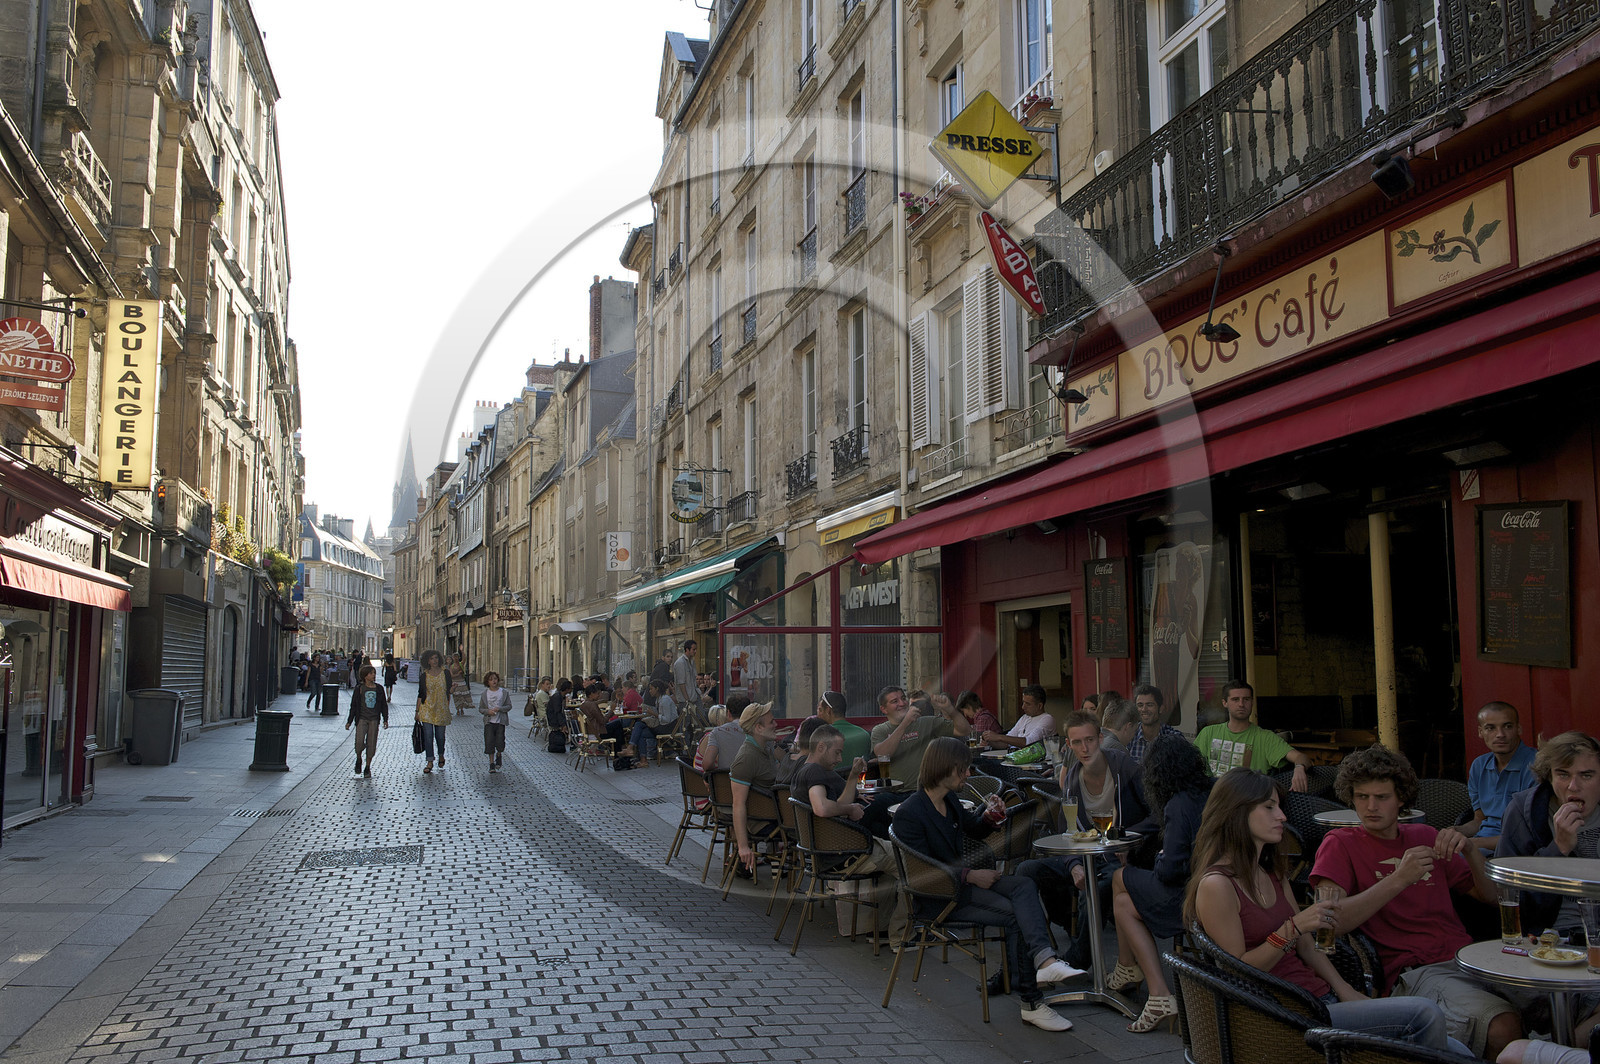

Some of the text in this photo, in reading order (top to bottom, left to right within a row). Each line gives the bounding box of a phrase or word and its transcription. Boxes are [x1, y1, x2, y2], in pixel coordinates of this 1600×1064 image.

[946, 133, 1033, 156] PRESSE
[989, 222, 1041, 304] TABAC
[1254, 257, 1346, 347] Café
[0, 352, 63, 374] NETTE
[1, 388, 27, 400] JÉRÔME
[114, 304, 147, 483] BOULANGERIE
[609, 534, 618, 568] NOMAD
[845, 579, 899, 610] KEY WEST
[499, 610, 522, 618] BIJOUX
